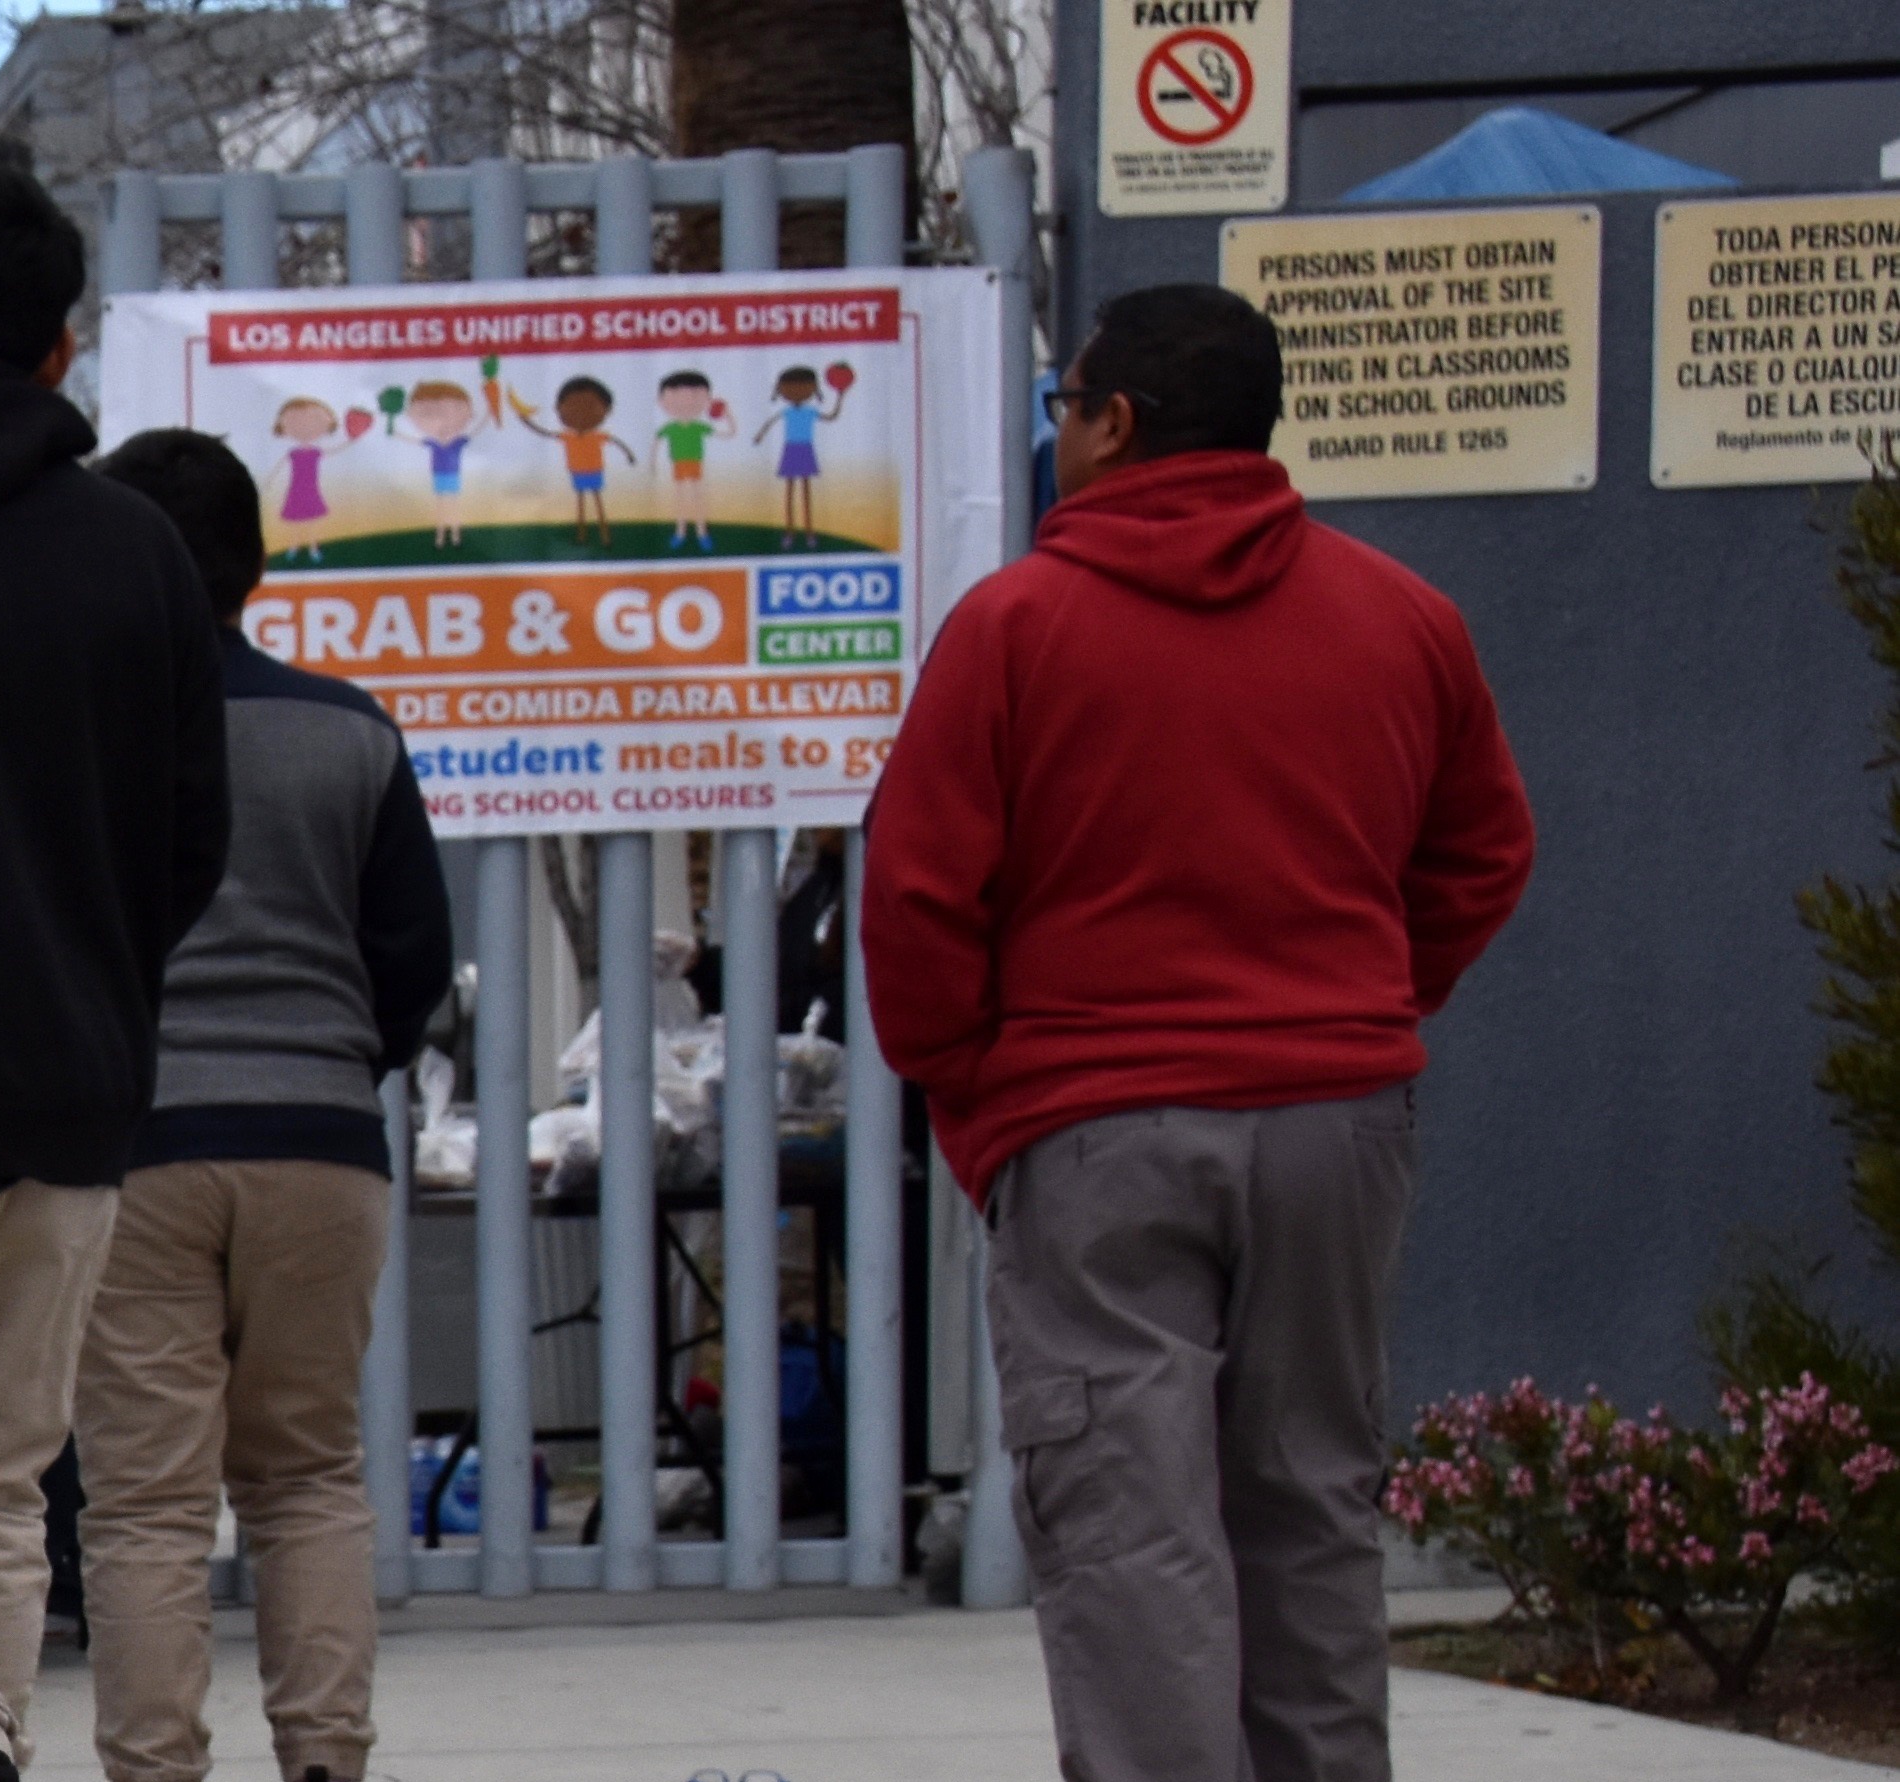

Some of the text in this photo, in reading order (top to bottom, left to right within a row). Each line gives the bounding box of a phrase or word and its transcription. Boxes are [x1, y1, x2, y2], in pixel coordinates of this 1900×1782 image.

[1133, 0, 1260, 26] FACILITY
[1715, 227, 1780, 252] TODA
[1259, 239, 1556, 281] PERSONS MUST OBTAIN
[1709, 257, 1825, 287] OBTENER
[1834, 256, 1864, 281] EL
[1263, 274, 1552, 317] APPROVAL OF THE SITE
[1688, 295, 1735, 322] DEL
[1747, 287, 1876, 319] DIRECTOR
[226, 300, 882, 353] LOS ANGELES UNIFIED SCHOOL DISTRICT
[1467, 309, 1564, 339] BEFORE
[1691, 324, 1794, 355] ENTRAR
[1805, 324, 1822, 350] A
[1833, 322, 1868, 348] UN
[1362, 356, 1388, 382] IN
[1397, 344, 1570, 380] CLASSROOMS
[1677, 358, 1758, 389] CLASE
[1767, 356, 1785, 385] O
[1295, 379, 1567, 421] ON SCHOOL GROUNDS
[1746, 391, 1778, 418] DE
[1788, 391, 1819, 417] LA
[1308, 426, 1508, 461] BOARD RULE 1265
[1716, 429, 1823, 453] Reglamento
[1829, 426, 1851, 445] de
[768, 570, 891, 608] FOOD
[241, 585, 724, 662] GRAB & GO
[765, 629, 895, 659] CENTER
[394, 678, 892, 723] DE COMIDA PARA LLEVAR
[409, 729, 898, 779] student meals to go
[474, 788, 600, 817] SCHOOL
[611, 782, 776, 813] CLOSURES
